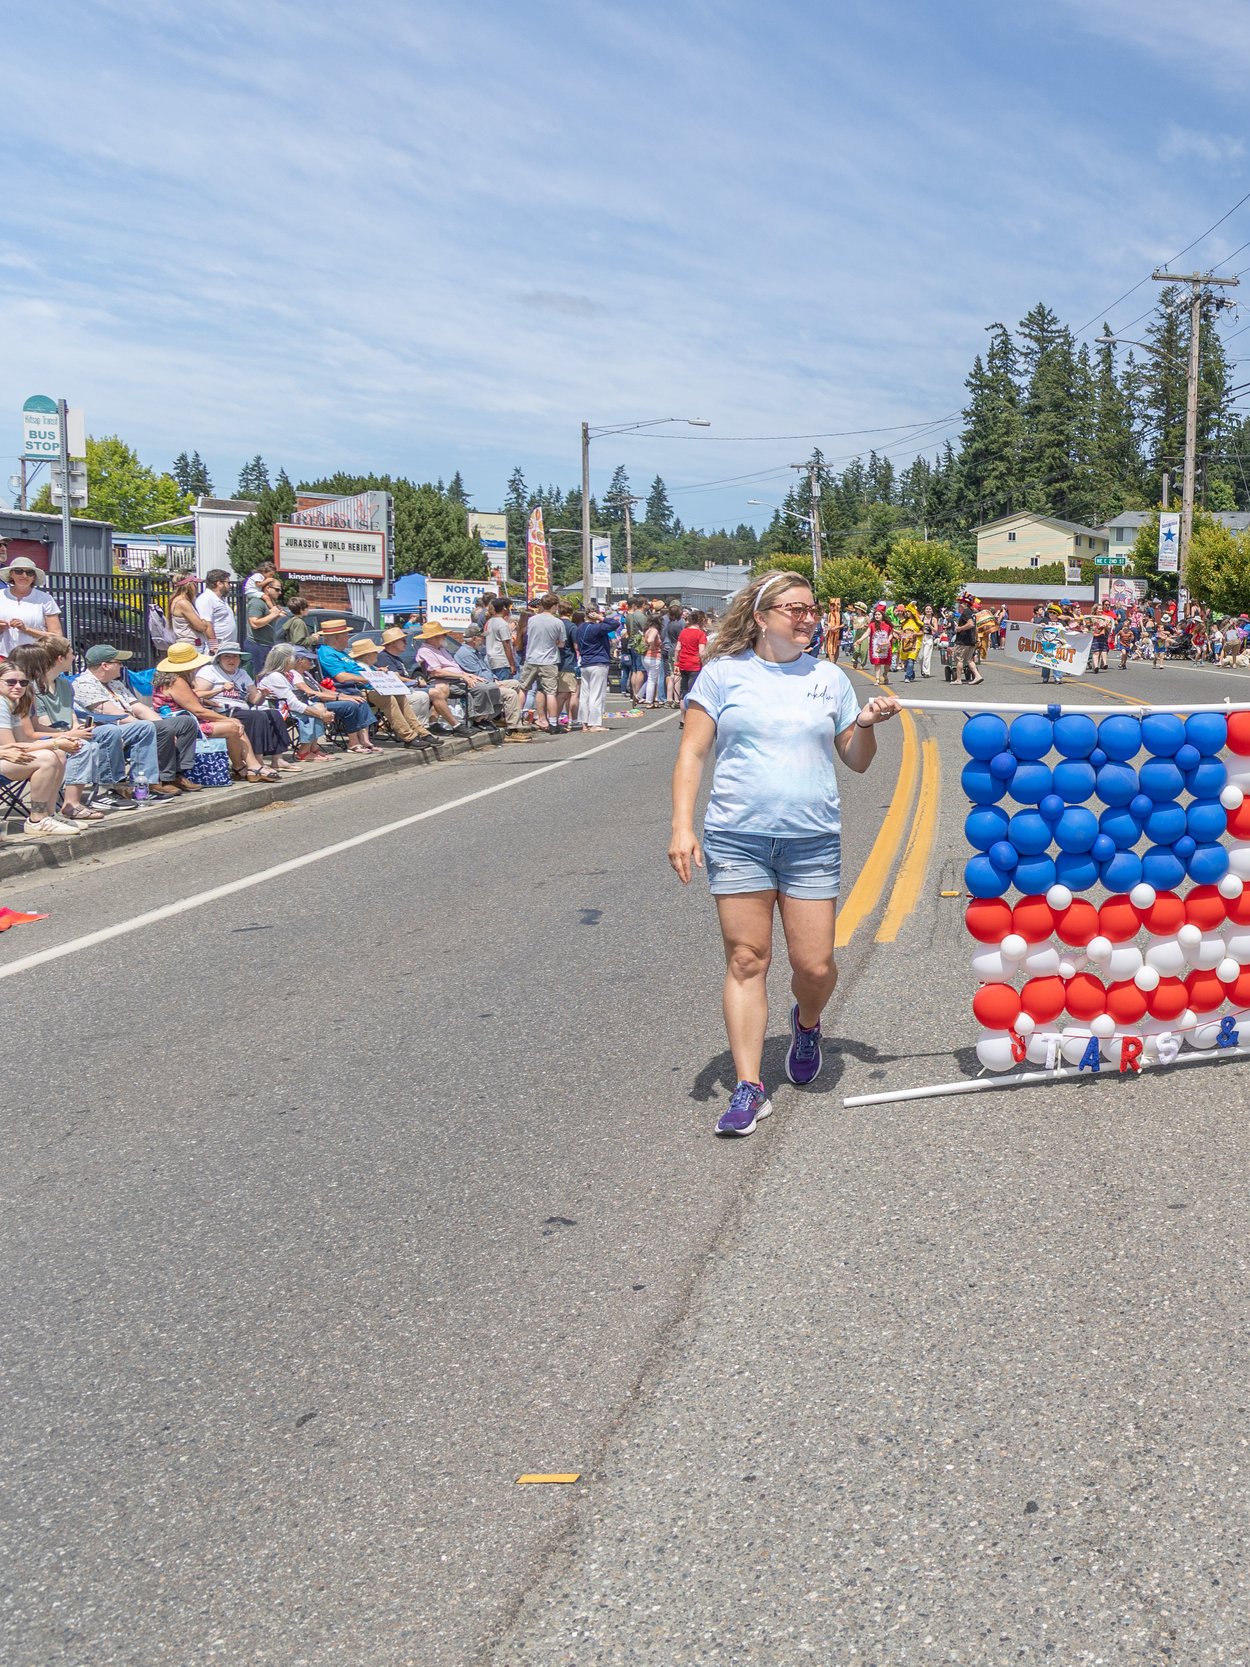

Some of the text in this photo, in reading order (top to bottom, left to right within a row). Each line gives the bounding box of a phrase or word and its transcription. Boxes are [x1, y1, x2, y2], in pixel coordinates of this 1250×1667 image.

[29, 430, 56, 440] BUS
[25, 441, 60, 451] STOP
[285, 538, 376, 552] JURASSIC WORLD REBIRTH
[532, 545, 549, 585] FOOD
[288, 573, 374, 584] kingstonfirehouse.com
[446, 585, 485, 594] NORTH
[443, 595, 478, 604] KITSA
[430, 605, 474, 614] INDIVIS
[1008, 1027, 1180, 1074] STARS
[1217, 1016, 1239, 1048] &
